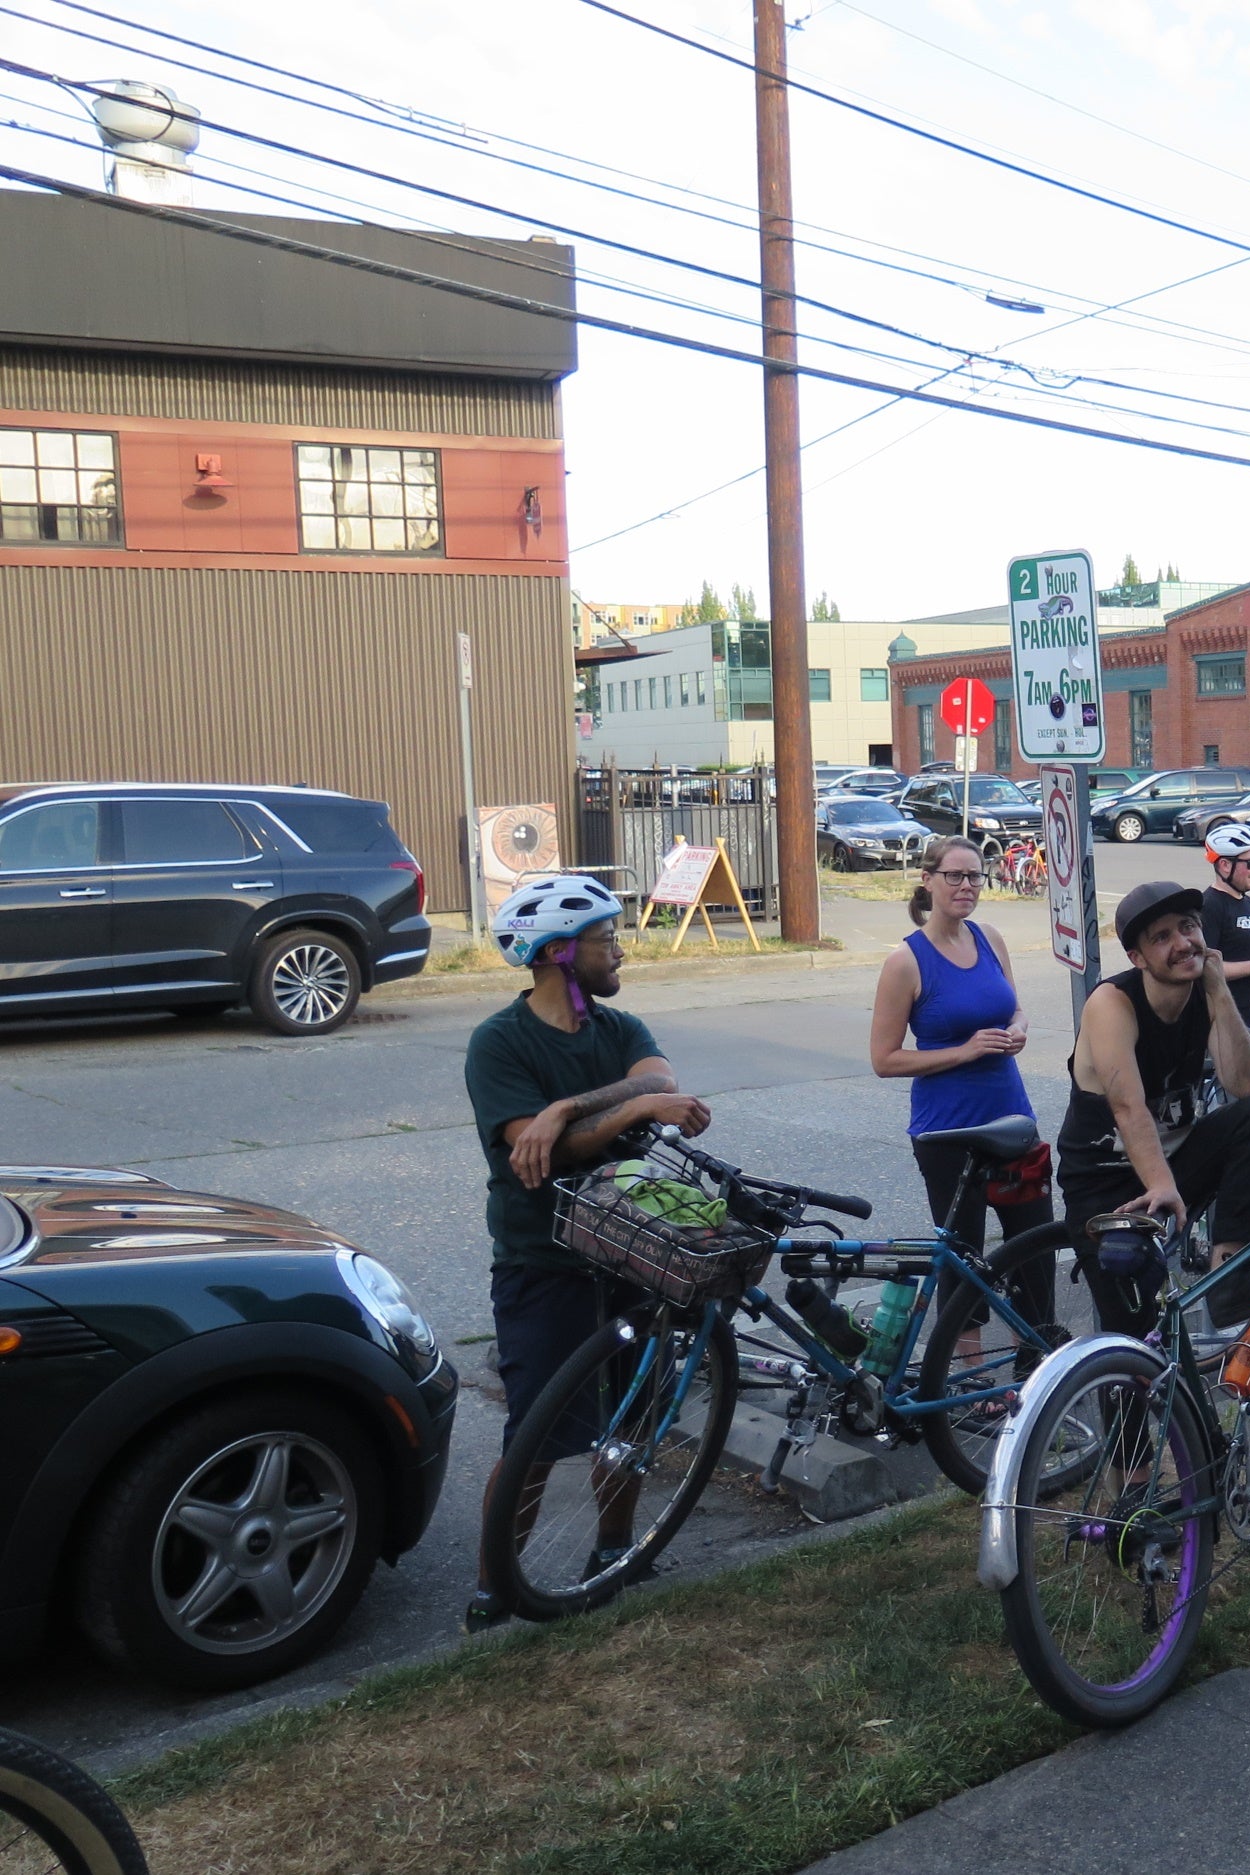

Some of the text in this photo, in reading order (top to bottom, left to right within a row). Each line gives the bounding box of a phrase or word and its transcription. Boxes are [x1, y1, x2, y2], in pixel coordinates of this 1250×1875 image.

[1019, 569, 1078, 596] 2 HOUR
[1020, 615, 1089, 650] PARKING
[1037, 728, 1056, 738] EXCEPT
[507, 919, 535, 930] KALI
